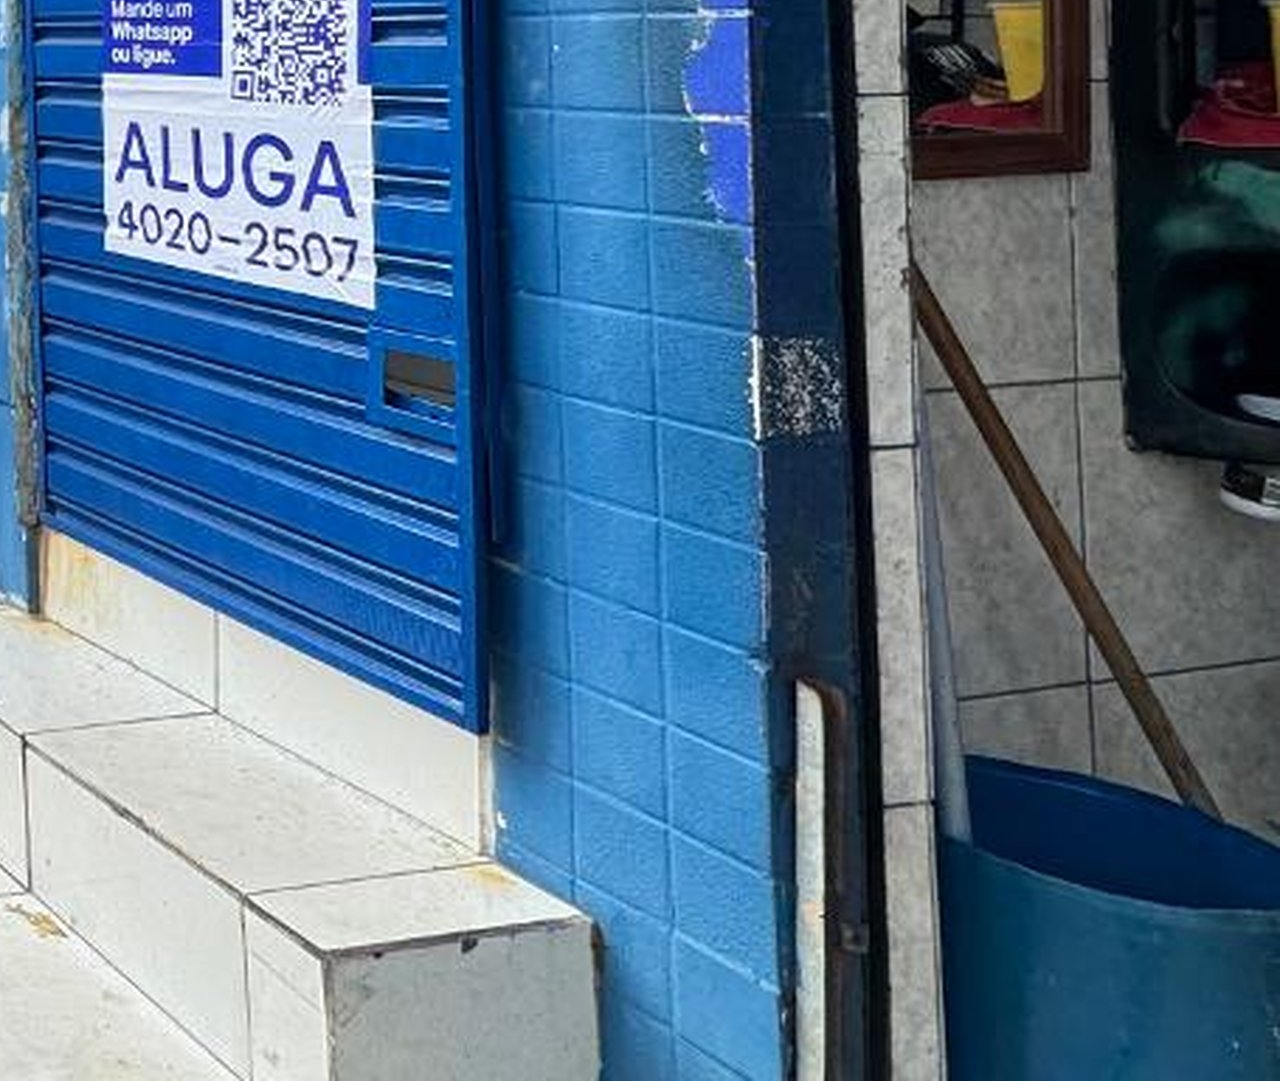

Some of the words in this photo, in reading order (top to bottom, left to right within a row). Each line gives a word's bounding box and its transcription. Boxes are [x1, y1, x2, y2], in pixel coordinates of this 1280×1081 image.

[111, 0, 163, 18] Mande
[165, 2, 193, 18] um
[111, 21, 193, 45] Whatsapp
[111, 47, 130, 63] ou
[132, 42, 176, 69] ligue.
[115, 121, 357, 218] ALUGA
[118, 200, 358, 282] 4020-2507
